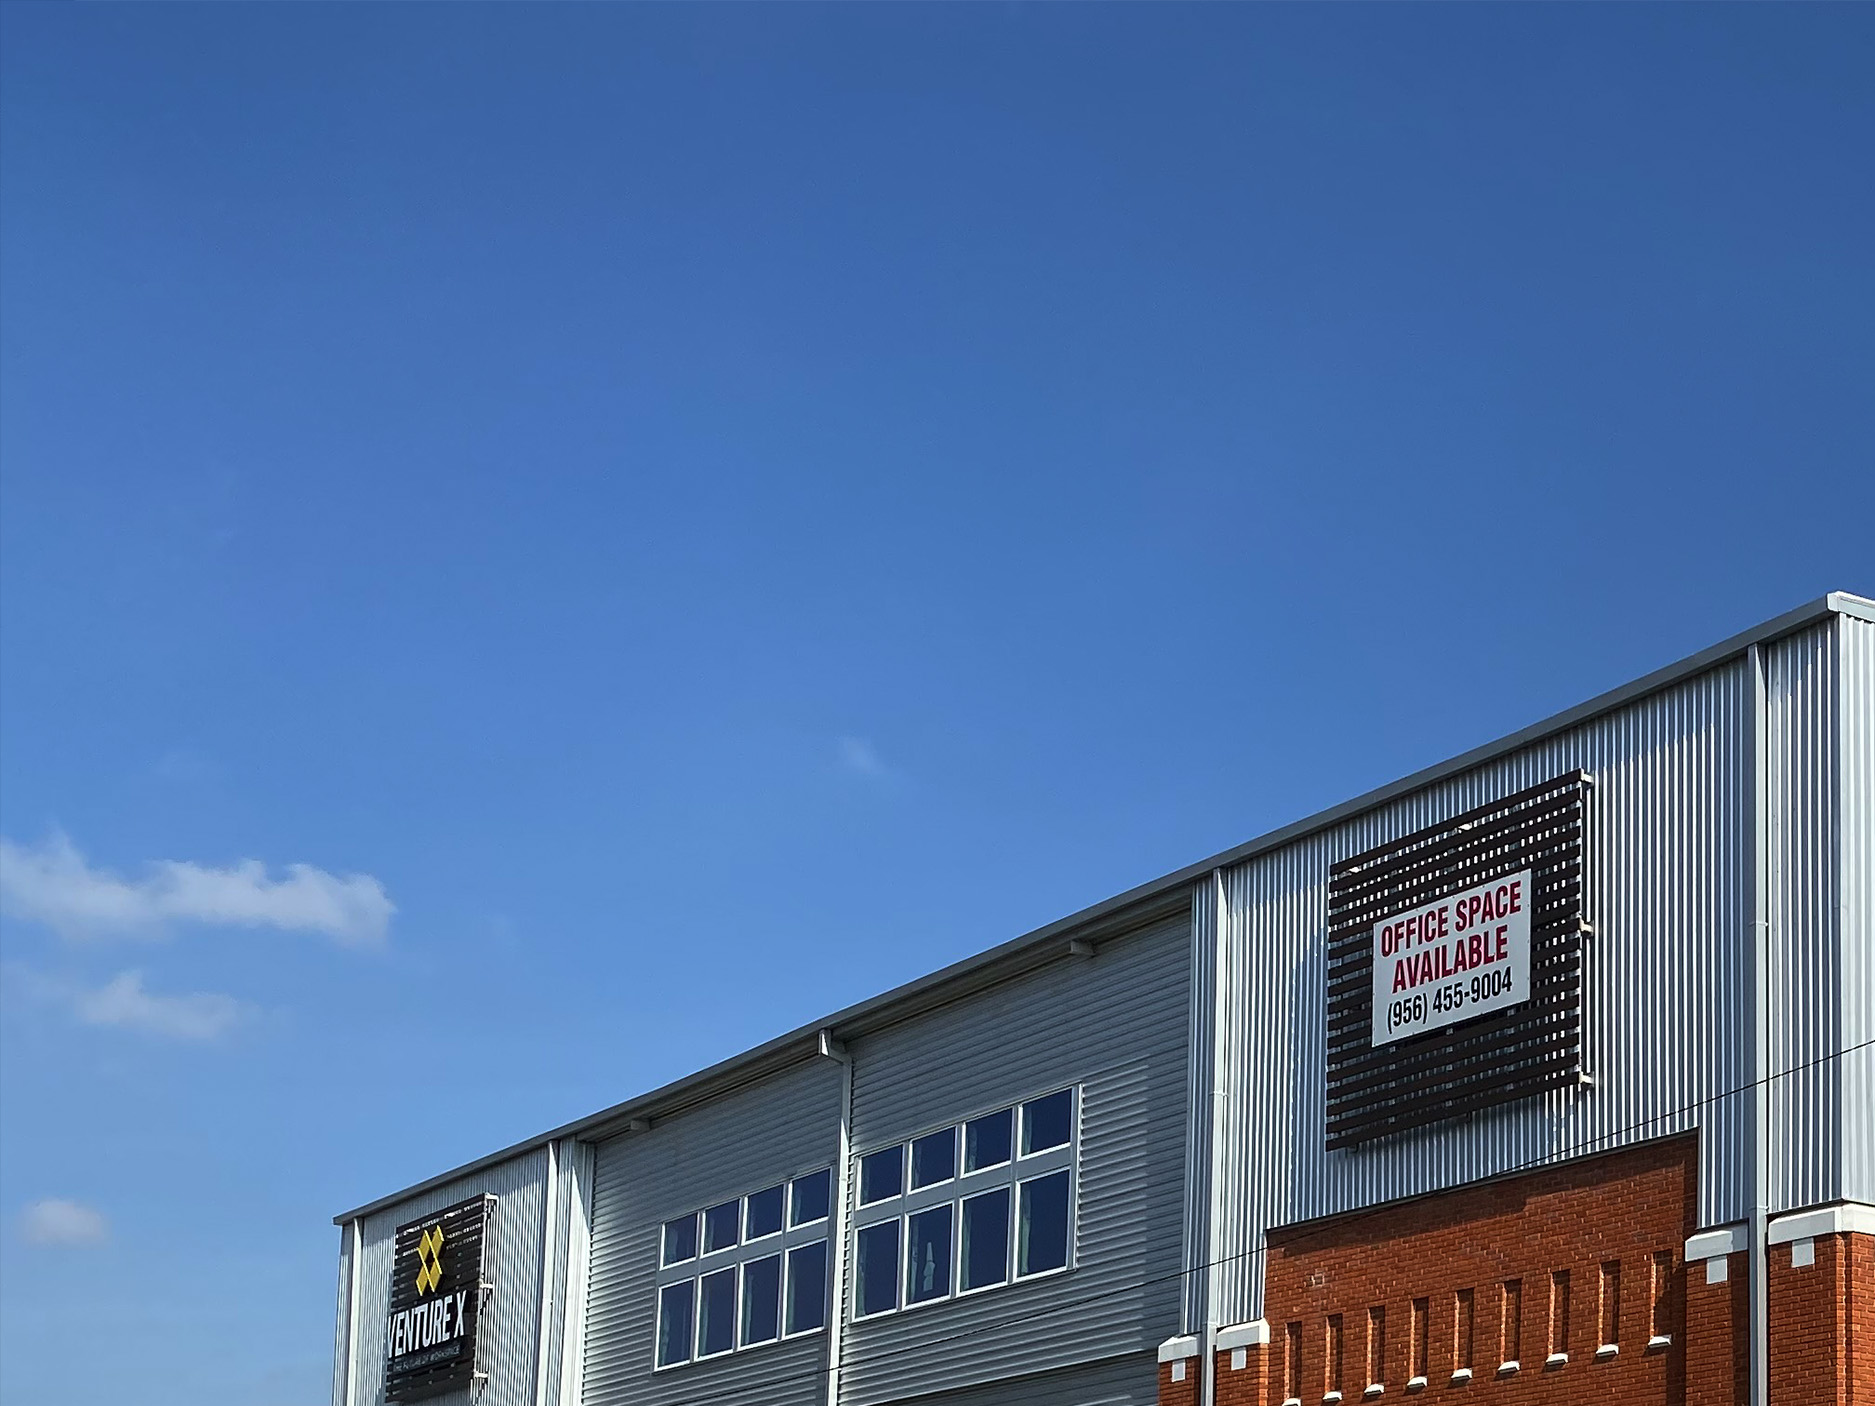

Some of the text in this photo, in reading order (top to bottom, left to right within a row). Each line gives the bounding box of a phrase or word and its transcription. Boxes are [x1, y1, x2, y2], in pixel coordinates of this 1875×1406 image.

[1381, 880, 1522, 958] OFFICE SPACE
[1392, 925, 1508, 994] AVAILABLE
[1387, 966, 1513, 1034] (956) 455-9004
[387, 1290, 467, 1358] VENTURE X
